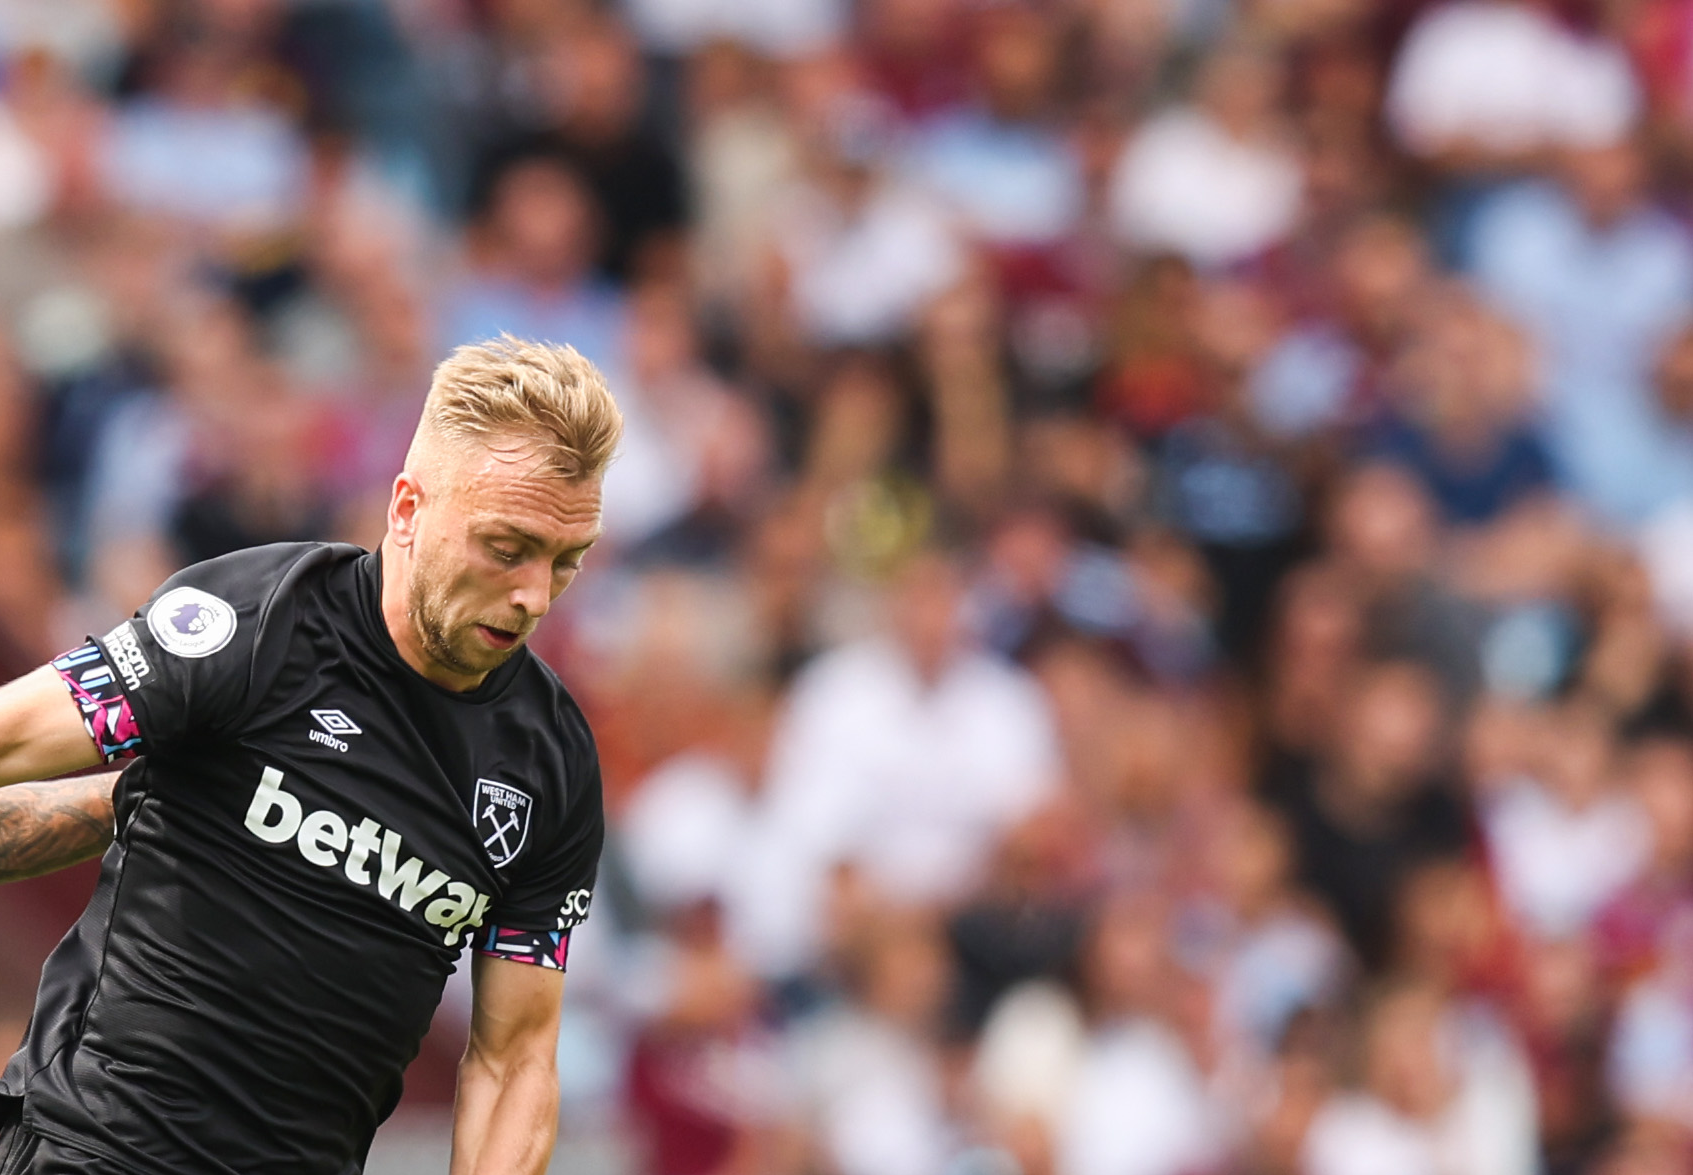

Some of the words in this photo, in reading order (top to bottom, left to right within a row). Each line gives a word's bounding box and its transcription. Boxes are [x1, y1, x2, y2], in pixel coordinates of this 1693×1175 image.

[308, 729, 349, 752] umbro
[481, 784, 506, 798] WEST
[505, 790, 526, 808] HAM
[490, 795, 517, 810] UNITED
[244, 765, 492, 947] betway
